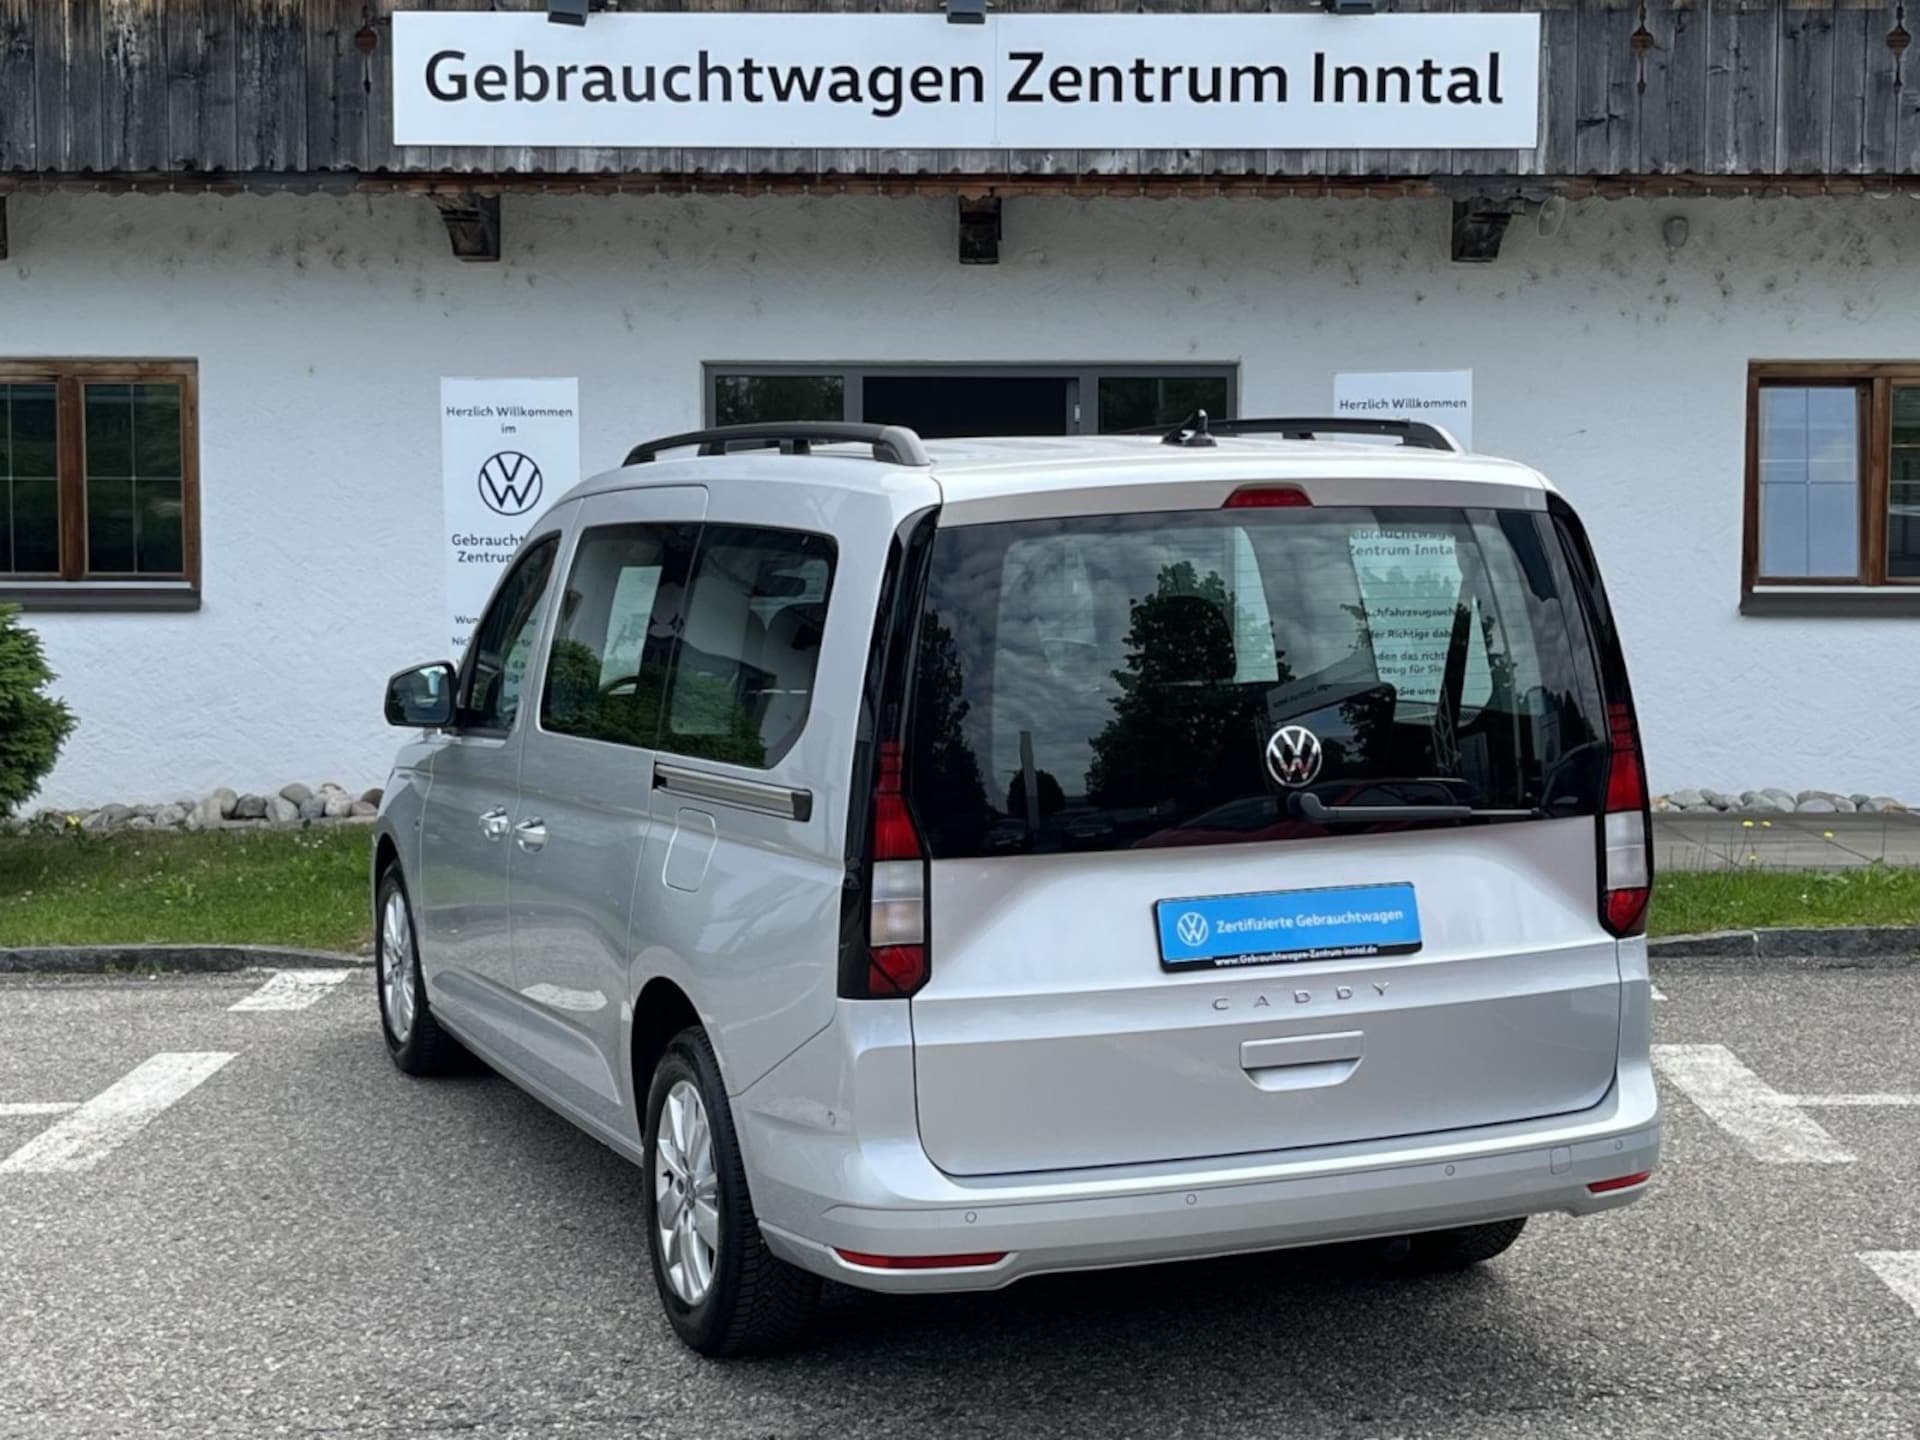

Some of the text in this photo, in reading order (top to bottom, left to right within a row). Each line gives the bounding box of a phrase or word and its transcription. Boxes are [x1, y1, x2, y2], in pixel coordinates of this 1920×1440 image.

[425, 49, 1504, 118] Gebrauchtwagen Zentrum Inntal
[446, 405, 573, 418] Herzlich Willkommen
[1339, 398, 1468, 411] Herzlich Willkommen
[500, 422, 517, 434] im
[478, 451, 543, 516] VW
[451, 533, 525, 547] Gebraucht
[1415, 543, 1455, 557] Innta
[1387, 629, 1430, 641] Richtige
[1409, 664, 1425, 674] für
[1216, 918, 1294, 934] Zertifizierte
[1295, 909, 1404, 928] Gebrauchtwagen
[1211, 981, 1391, 1011] CADDY
